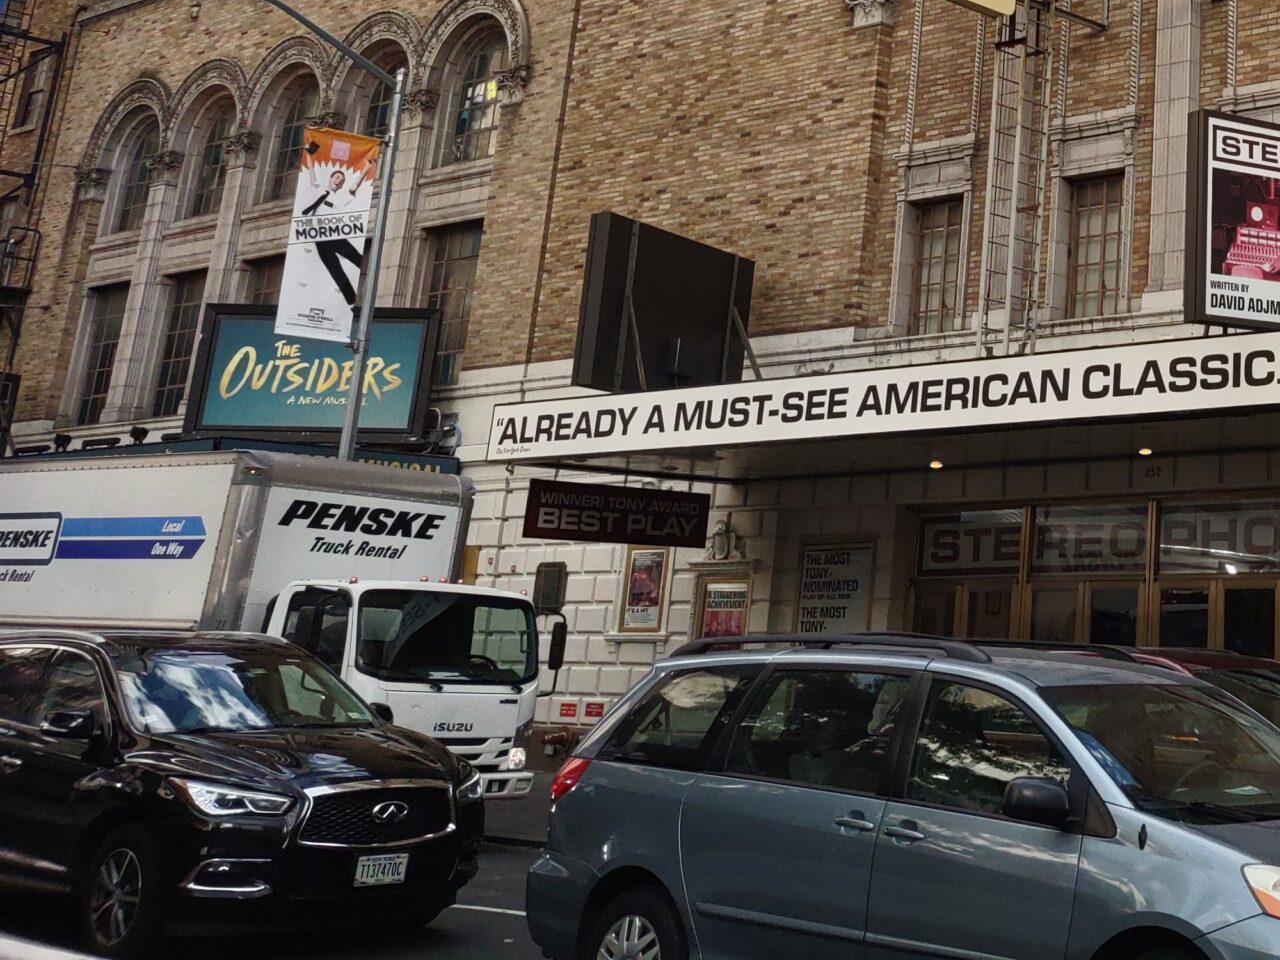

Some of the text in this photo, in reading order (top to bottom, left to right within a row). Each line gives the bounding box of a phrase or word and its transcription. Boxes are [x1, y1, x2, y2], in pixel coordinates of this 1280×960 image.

[294, 213, 364, 230] THE BOOK OF
[295, 221, 365, 241] MORMON
[1210, 280, 1250, 293] WRITTEN BY
[1210, 293, 1245, 310] DAVID
[275, 340, 302, 357] THE
[287, 395, 296, 405] A
[298, 395, 322, 405] NEW
[642, 404, 668, 435] A
[673, 386, 850, 433] MUST-SEE
[856, 367, 1071, 418] AMERICAN
[540, 491, 700, 514] WINNER! TONY AWARD
[161, 520, 185, 533] Local
[277, 499, 446, 540] PENSKE
[537, 507, 698, 537] BEST PLAY
[151, 542, 185, 557] One Way
[309, 537, 408, 560] Truck Rental
[806, 552, 852, 566] THE MOST
[8, 569, 36, 583] Rental
[805, 567, 832, 580] TONY-
[803, 580, 859, 593] NOMINATED
[801, 606, 847, 619] THE MOST
[800, 621, 827, 633] TONY-
[433, 722, 474, 732] ISUZU
[360, 861, 403, 880] T137470C
